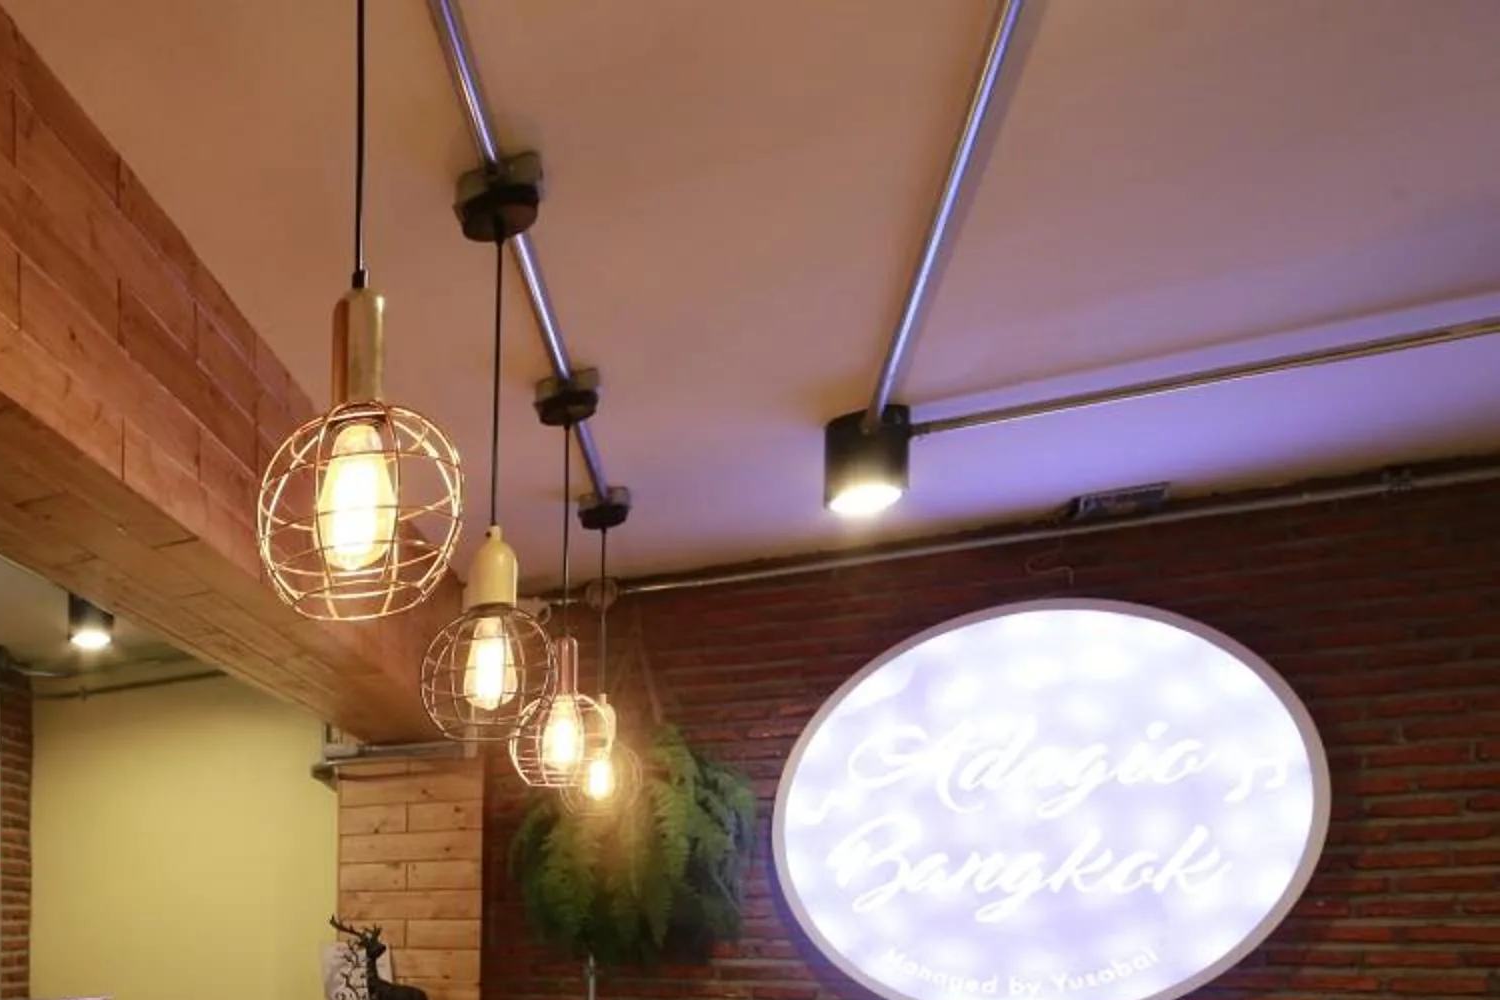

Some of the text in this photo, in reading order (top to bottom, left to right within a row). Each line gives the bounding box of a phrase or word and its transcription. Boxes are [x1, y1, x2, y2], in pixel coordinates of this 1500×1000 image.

[848, 714, 1219, 819] Adagio
[826, 812, 1232, 922] Bangkok
[880, 945, 1160, 997] Managed by Yusabai
